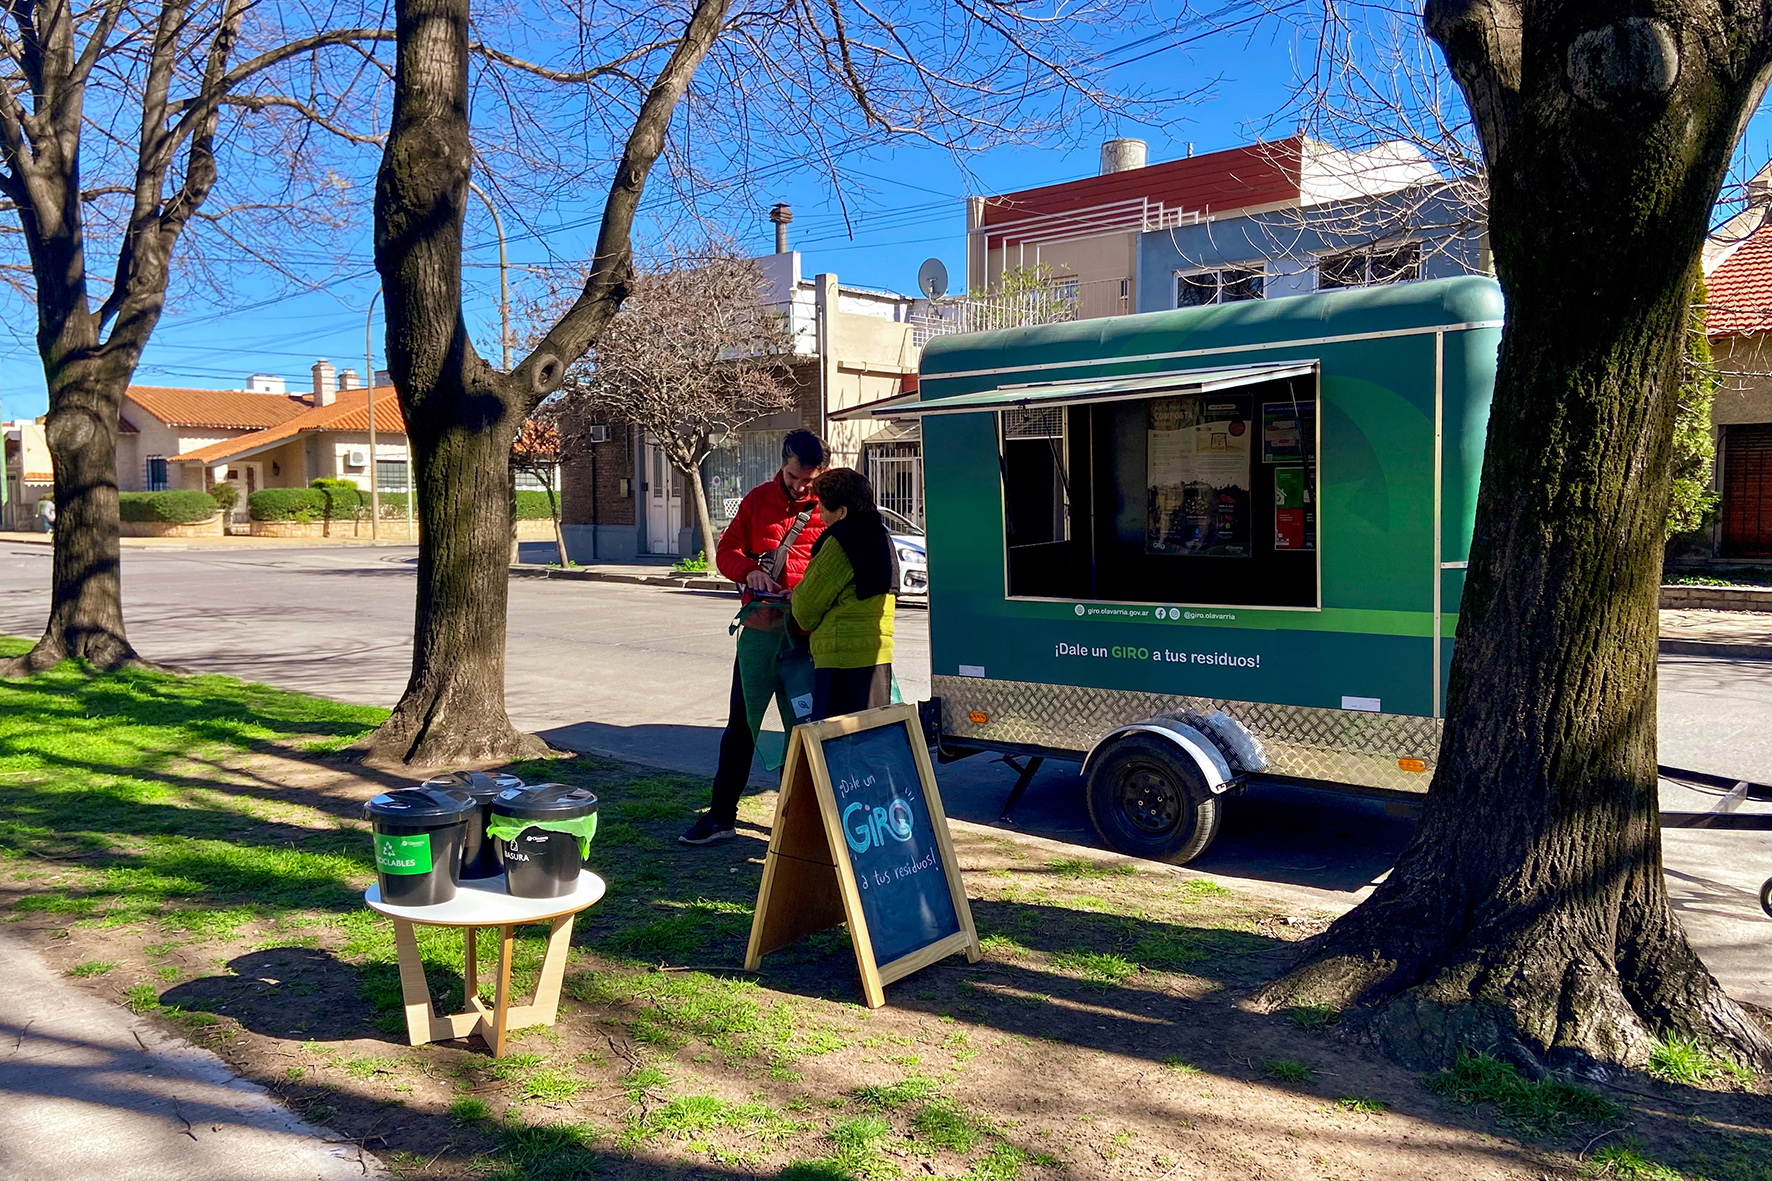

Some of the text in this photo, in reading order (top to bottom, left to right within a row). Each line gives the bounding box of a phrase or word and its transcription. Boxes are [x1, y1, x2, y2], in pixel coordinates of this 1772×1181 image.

[1087, 607, 1149, 617] giro.olavarria.gov.ar
[1184, 611, 1236, 620] @giro.olavarria
[1055, 642, 1260, 668] ¡Dale un GIRO a tus residuos!
[839, 775, 876, 799] ¡Dale un
[861, 847, 940, 890] a tus residuos!
